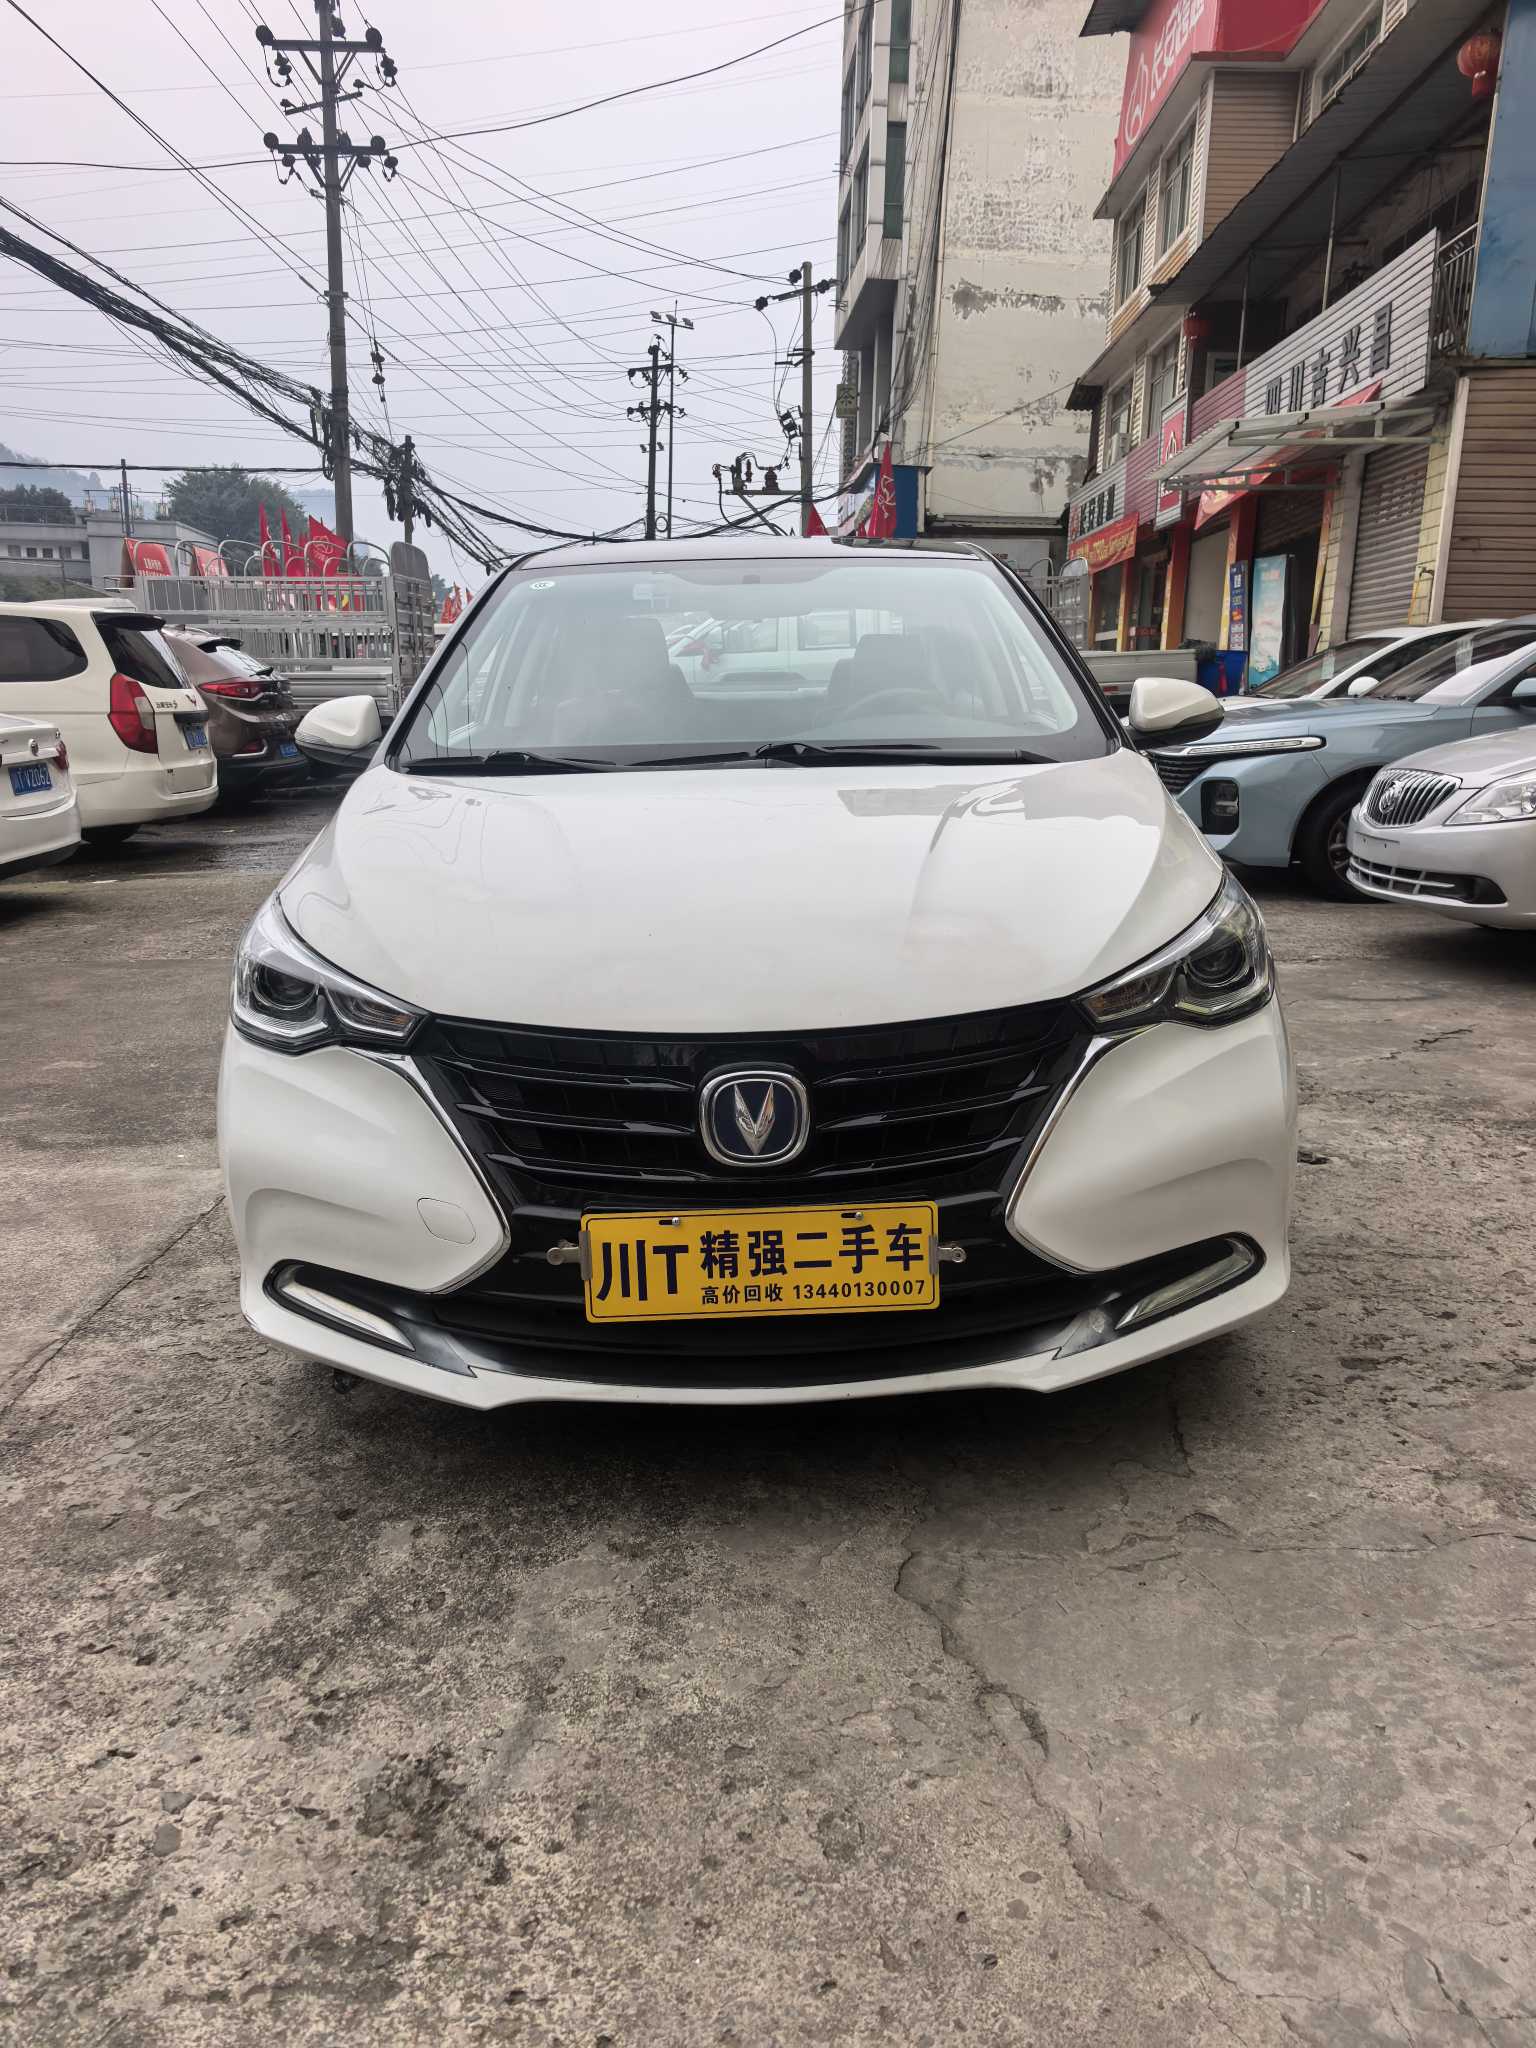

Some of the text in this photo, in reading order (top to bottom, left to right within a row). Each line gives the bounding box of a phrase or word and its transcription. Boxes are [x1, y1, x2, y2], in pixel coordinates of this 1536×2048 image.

[1265, 301, 1393, 416] 四川吉兴昌
[596, 1222, 925, 1301] 川T 精强二手车
[701, 1279, 925, 1305] 高价回收 13440130007
